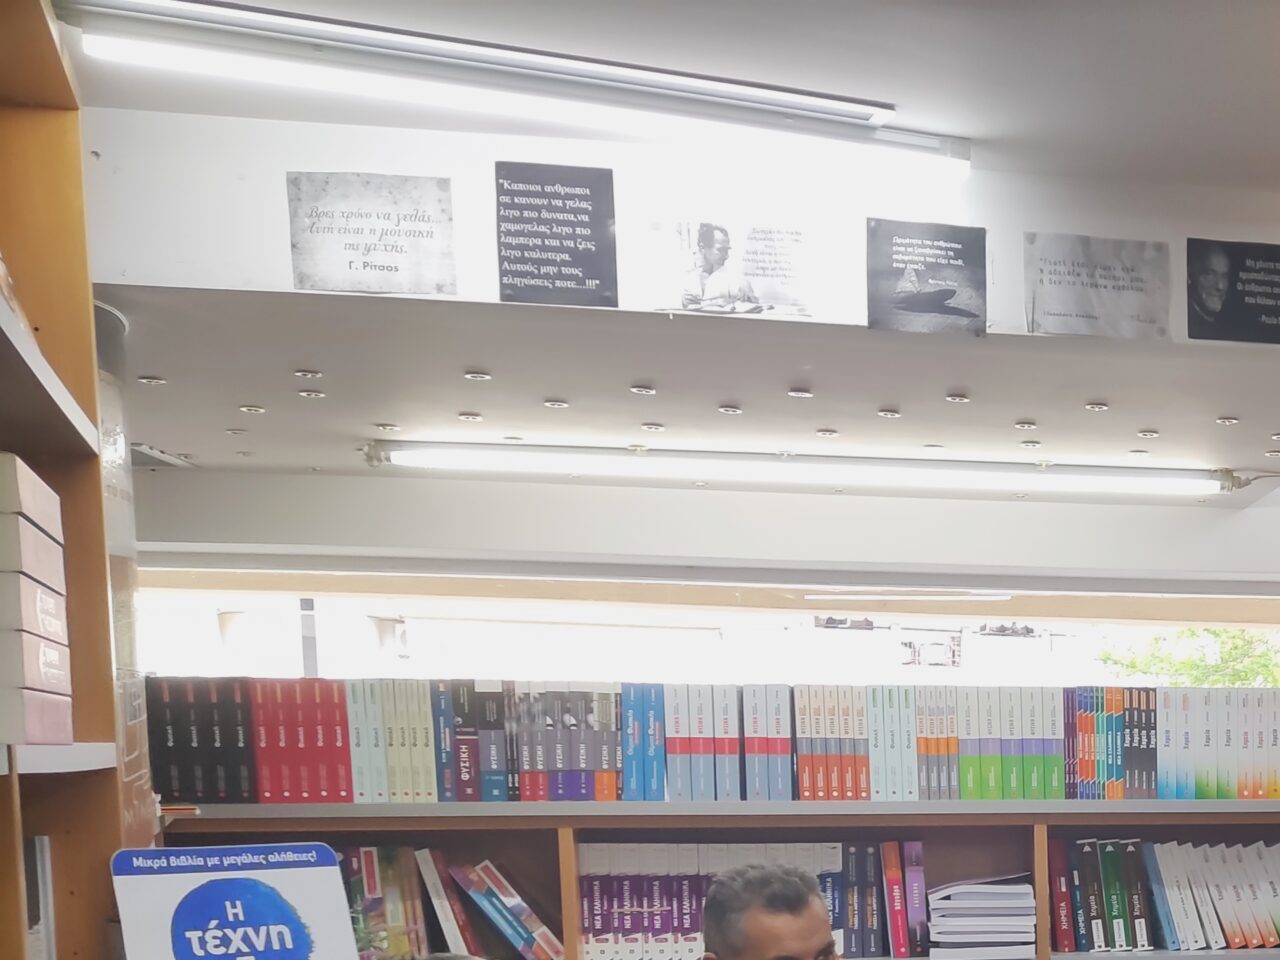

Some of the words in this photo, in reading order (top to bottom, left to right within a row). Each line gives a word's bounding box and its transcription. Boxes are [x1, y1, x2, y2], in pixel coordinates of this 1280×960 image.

[544, 184, 590, 195] ανθρωποι
[499, 195, 511, 203] σε
[514, 196, 548, 205] κανουν
[565, 199, 592, 211] γελας
[376, 212, 391, 220] να
[499, 207, 520, 218] λιγο
[523, 210, 538, 218] πιο
[499, 222, 551, 234] χαμογελας
[552, 224, 572, 235] λιγο
[575, 226, 591, 235] πιο
[500, 234, 542, 246] λαμπερα
[544, 238, 560, 246] και
[577, 239, 596, 251] ζεις
[500, 247, 521, 258] λιγο
[348, 261, 358, 270] Γ.
[540, 265, 558, 275] μην
[560, 266, 583, 277] τους
[460, 745, 470, 780] ΦΥΣΙΚΗ
[490, 744, 498, 769] ΦΥΣΙΚΗ
[556, 744, 564, 768] ΦΥΣΙΚΗ
[133, 856, 167, 870] Μικρά
[169, 853, 204, 867] βιβλία
[207, 856, 221, 867] με
[223, 853, 266, 867] μεγάλες
[268, 850, 317, 862] αλήθειες!
[593, 880, 602, 914] ΕΛΛΗΝΙΚΑ
[681, 880, 690, 913] ΕΛΛΗΝΙΚΑ
[1111, 895, 1120, 916] Χημεία
[1132, 894, 1142, 916] Χημεία
[224, 900, 245, 922] Η
[1089, 895, 1098, 917] Χημεία
[594, 915, 603, 929] ΝΕΑ
[623, 915, 632, 929] ΝΕΑ
[653, 915, 662, 929] ΝΕΑ
[682, 914, 691, 928] ΝΕΑ
[1060, 901, 1069, 930] ΧΗΜΕΙΑ
[1077, 909, 1087, 935] ΧΗΜΕΙΑ
[185, 920, 294, 957] τέχνη
